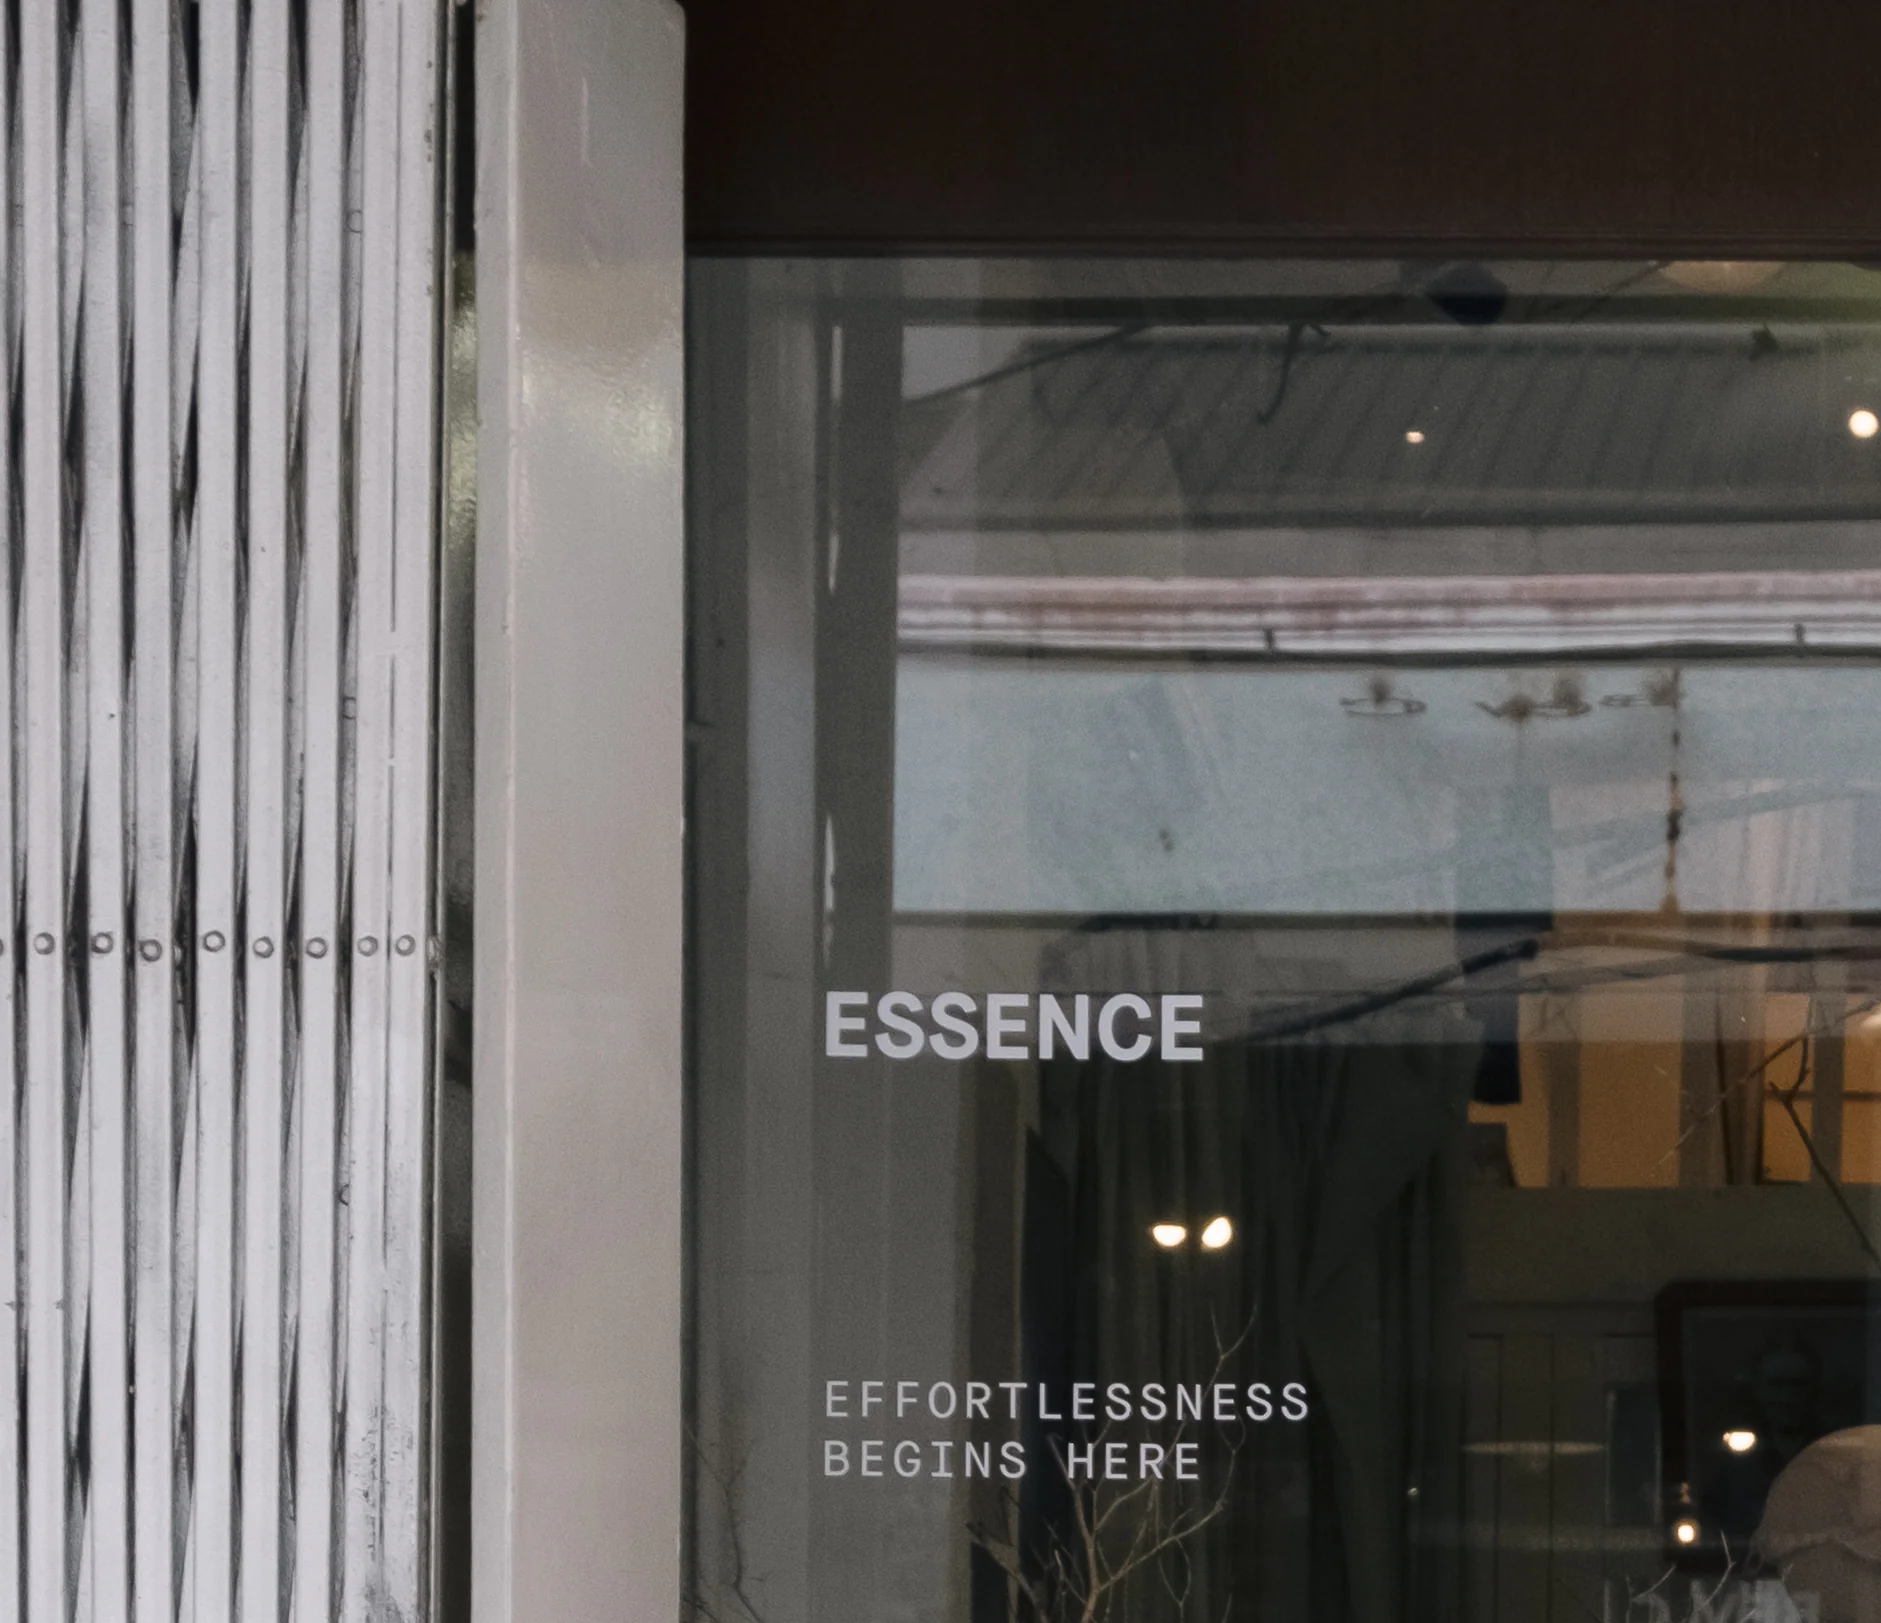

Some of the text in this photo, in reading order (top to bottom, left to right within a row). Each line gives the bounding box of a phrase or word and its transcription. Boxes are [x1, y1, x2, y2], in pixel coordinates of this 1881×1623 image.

[826, 991, 1204, 1061] ESSENCE
[825, 1380, 1309, 1422] EFFORTLESSNESS
[824, 1440, 1200, 1480] BEGINS HERE
